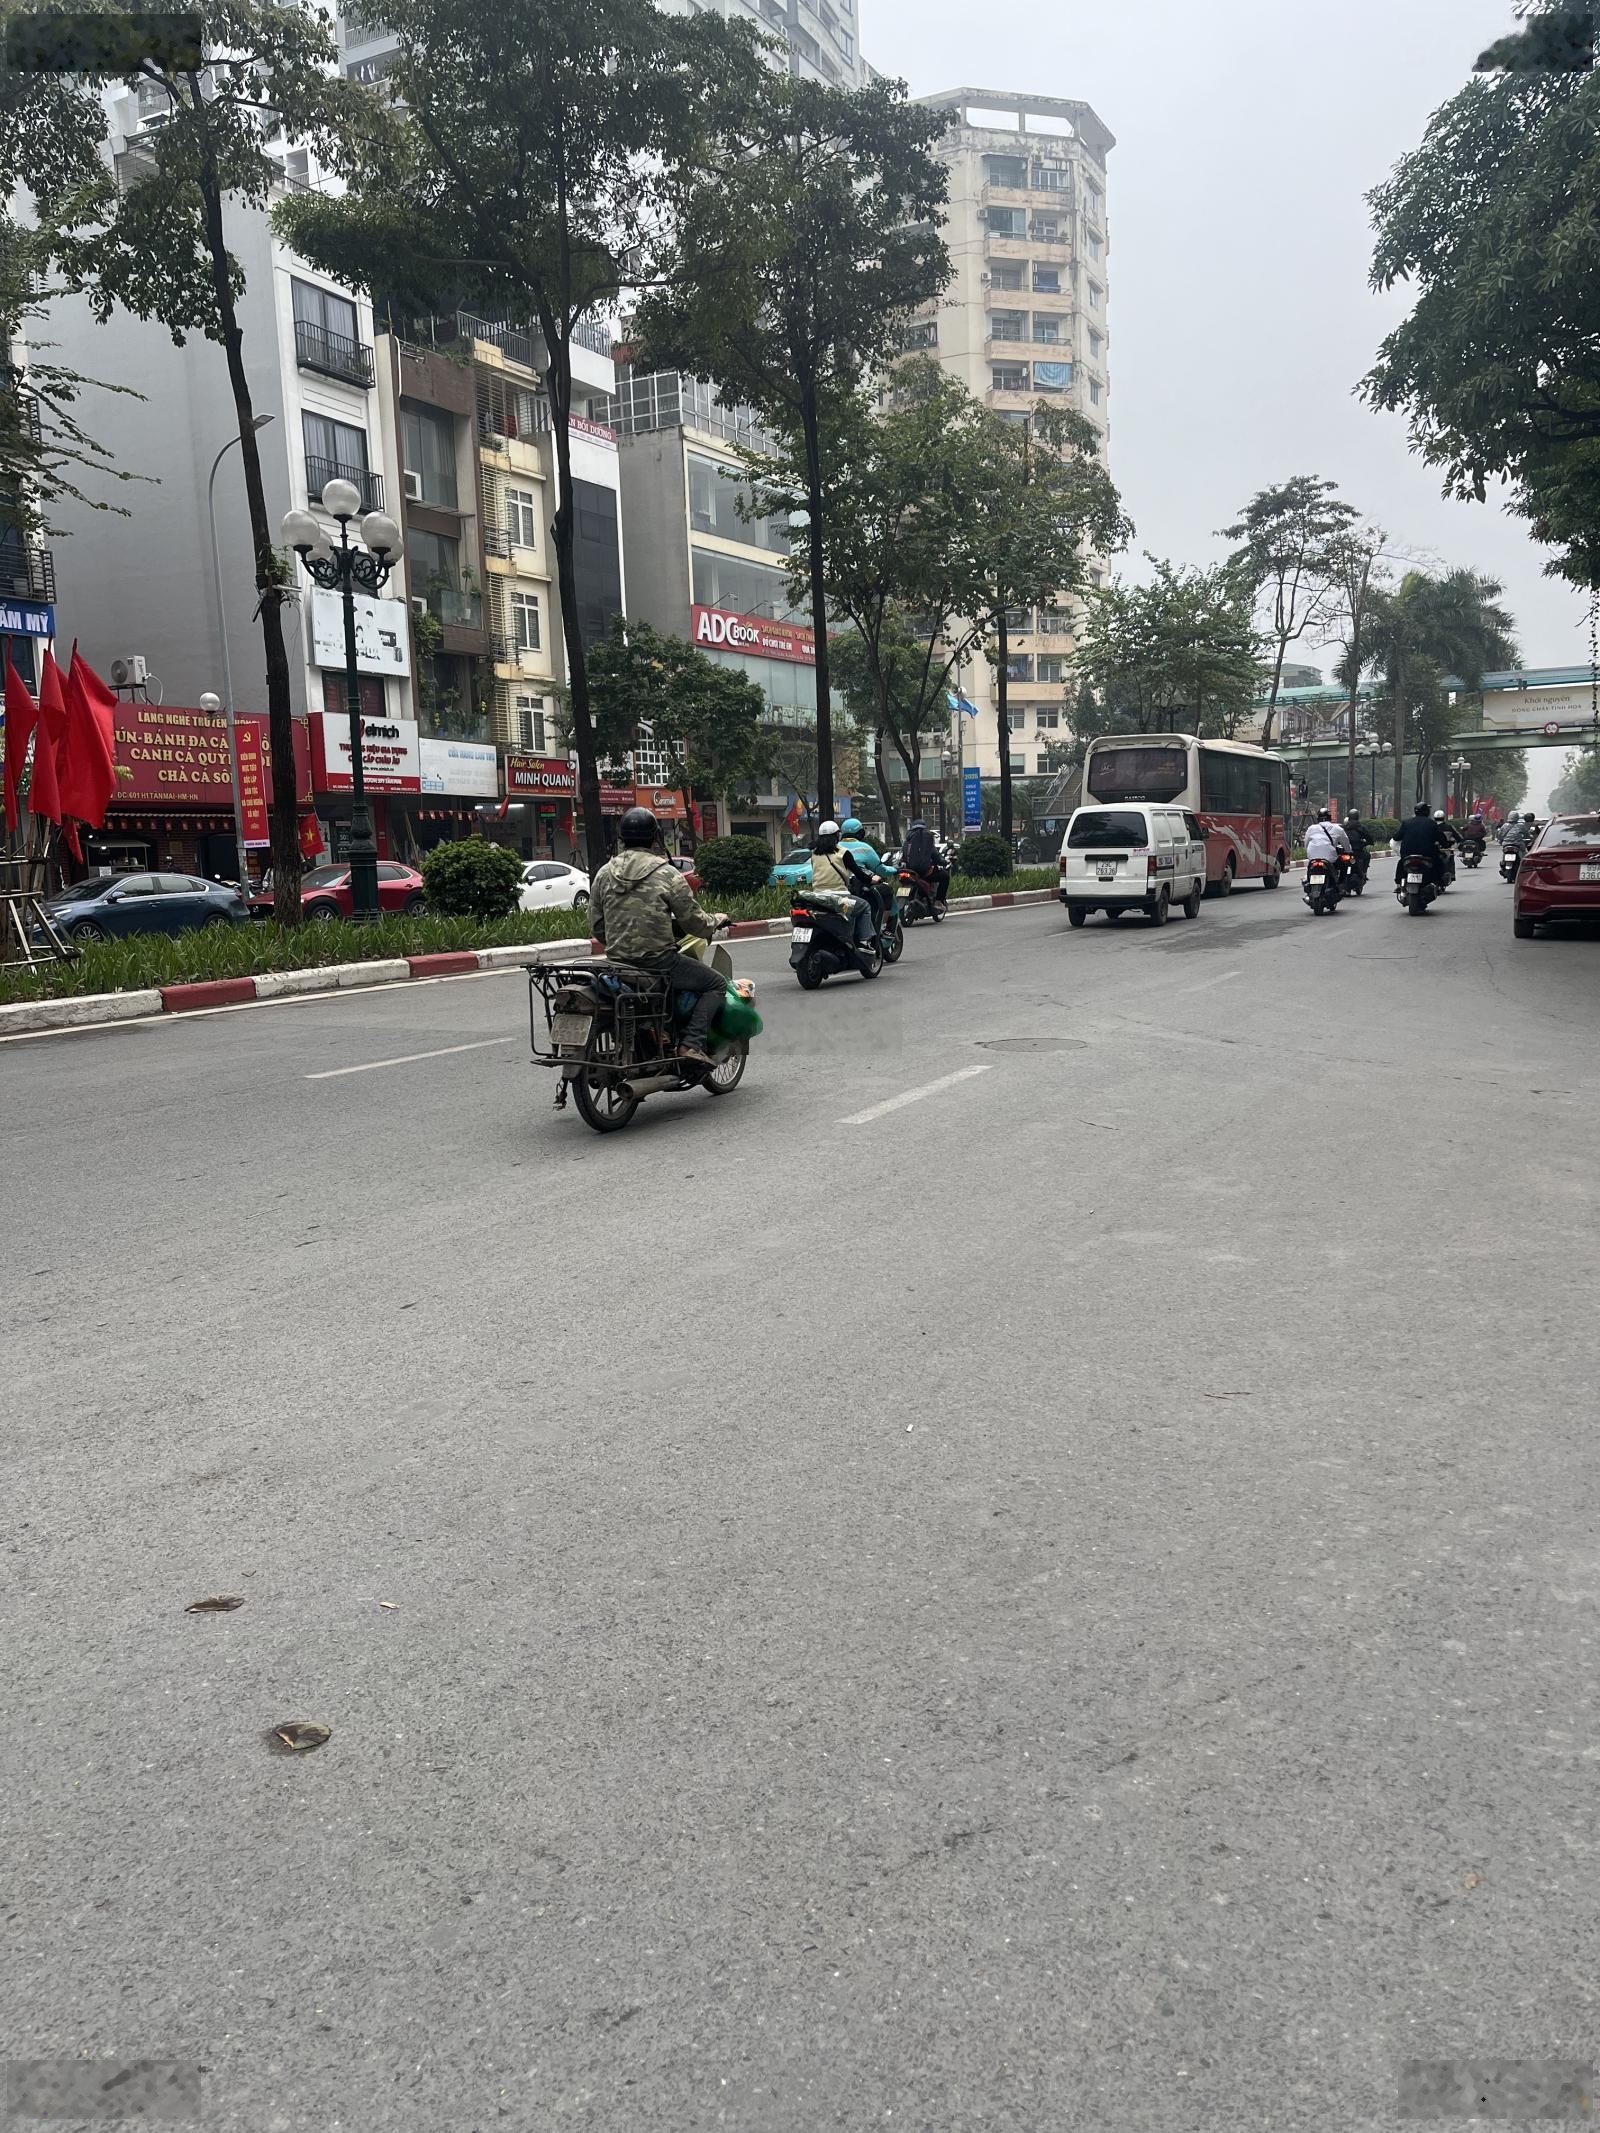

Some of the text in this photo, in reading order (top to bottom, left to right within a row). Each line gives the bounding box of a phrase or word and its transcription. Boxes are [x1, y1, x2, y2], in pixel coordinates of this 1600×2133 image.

[26, 611, 48, 633] MỸ
[696, 611, 760, 646] ADC BOOK
[138, 709, 164, 724] LÀNG
[114, 727, 185, 746] ÚN-BÁNH
[188, 735, 208, 748] ĐA
[130, 747, 231, 767] CANH CÁ QUỲ
[510, 757, 545, 770] Hair Salon
[158, 766, 232, 784] CHẢ CÁ SÔ
[515, 772, 575, 788] MINH QUANG
